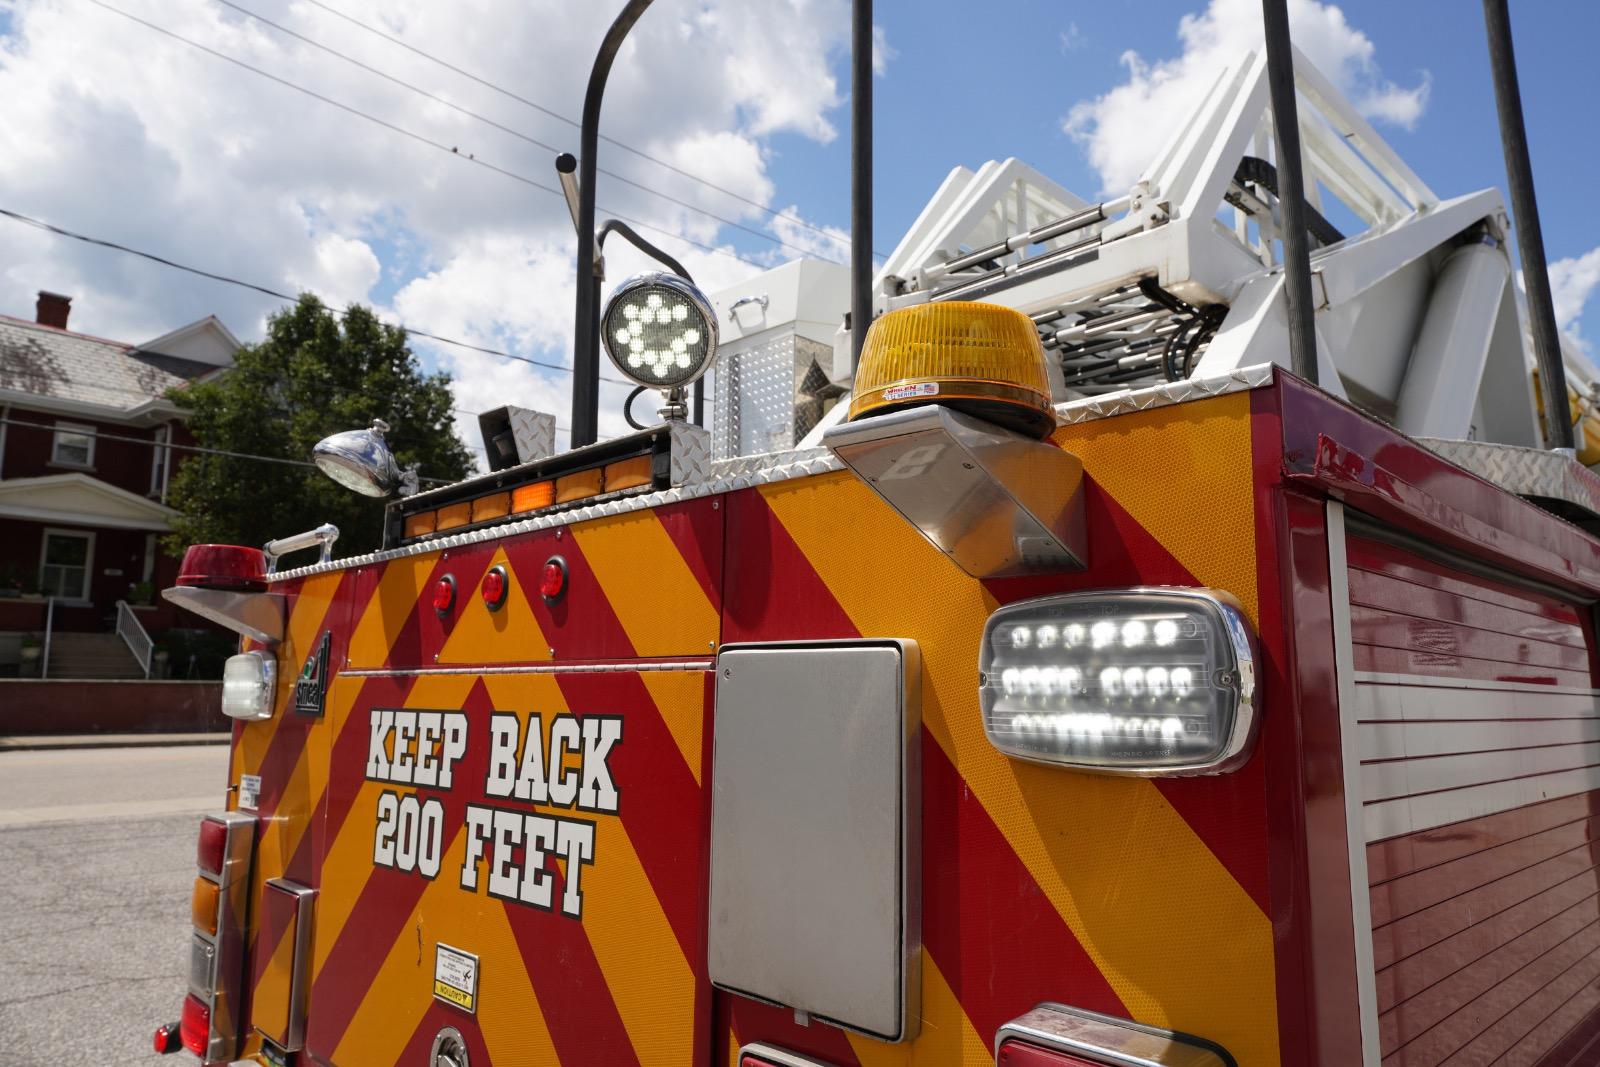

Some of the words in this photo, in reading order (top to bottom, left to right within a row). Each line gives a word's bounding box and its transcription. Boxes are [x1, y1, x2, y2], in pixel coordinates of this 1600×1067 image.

[887, 385, 917, 394] WHELEN
[366, 710, 468, 788] KEEP
[485, 714, 622, 811] BACK
[374, 793, 444, 878] 200
[461, 805, 595, 916] FEET
